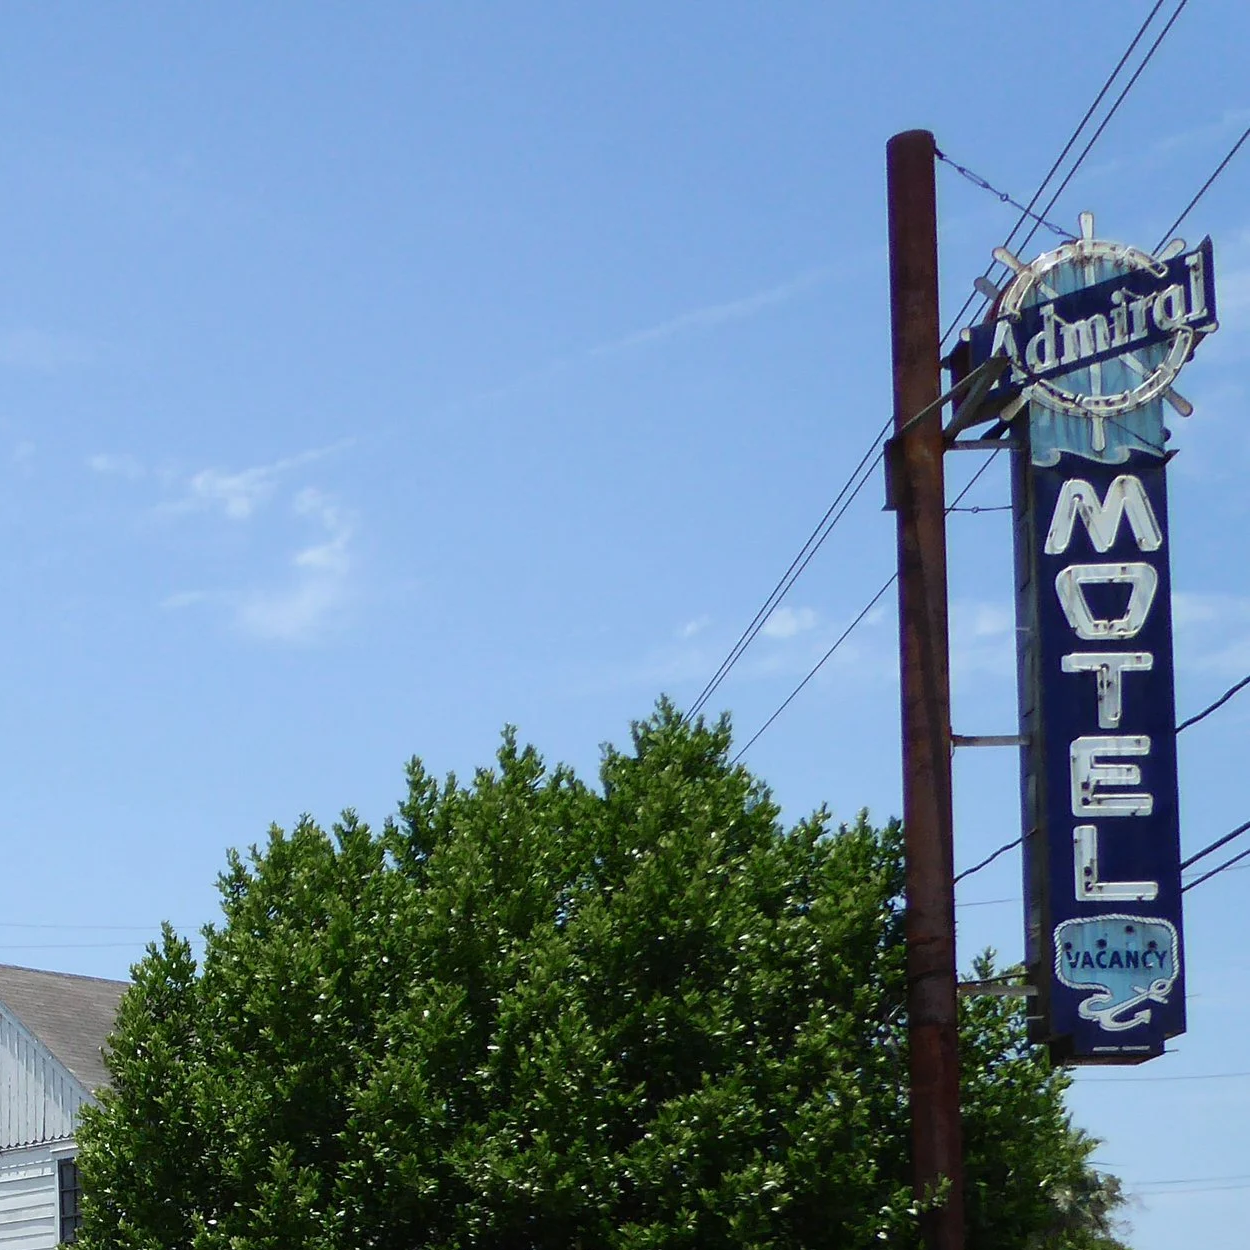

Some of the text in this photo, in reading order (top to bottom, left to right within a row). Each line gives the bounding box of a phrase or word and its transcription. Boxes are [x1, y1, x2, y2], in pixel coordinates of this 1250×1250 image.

[990, 250, 1207, 391] Admiral
[1043, 474, 1163, 902] MOTEL
[1065, 949, 1168, 970] VACANCY
